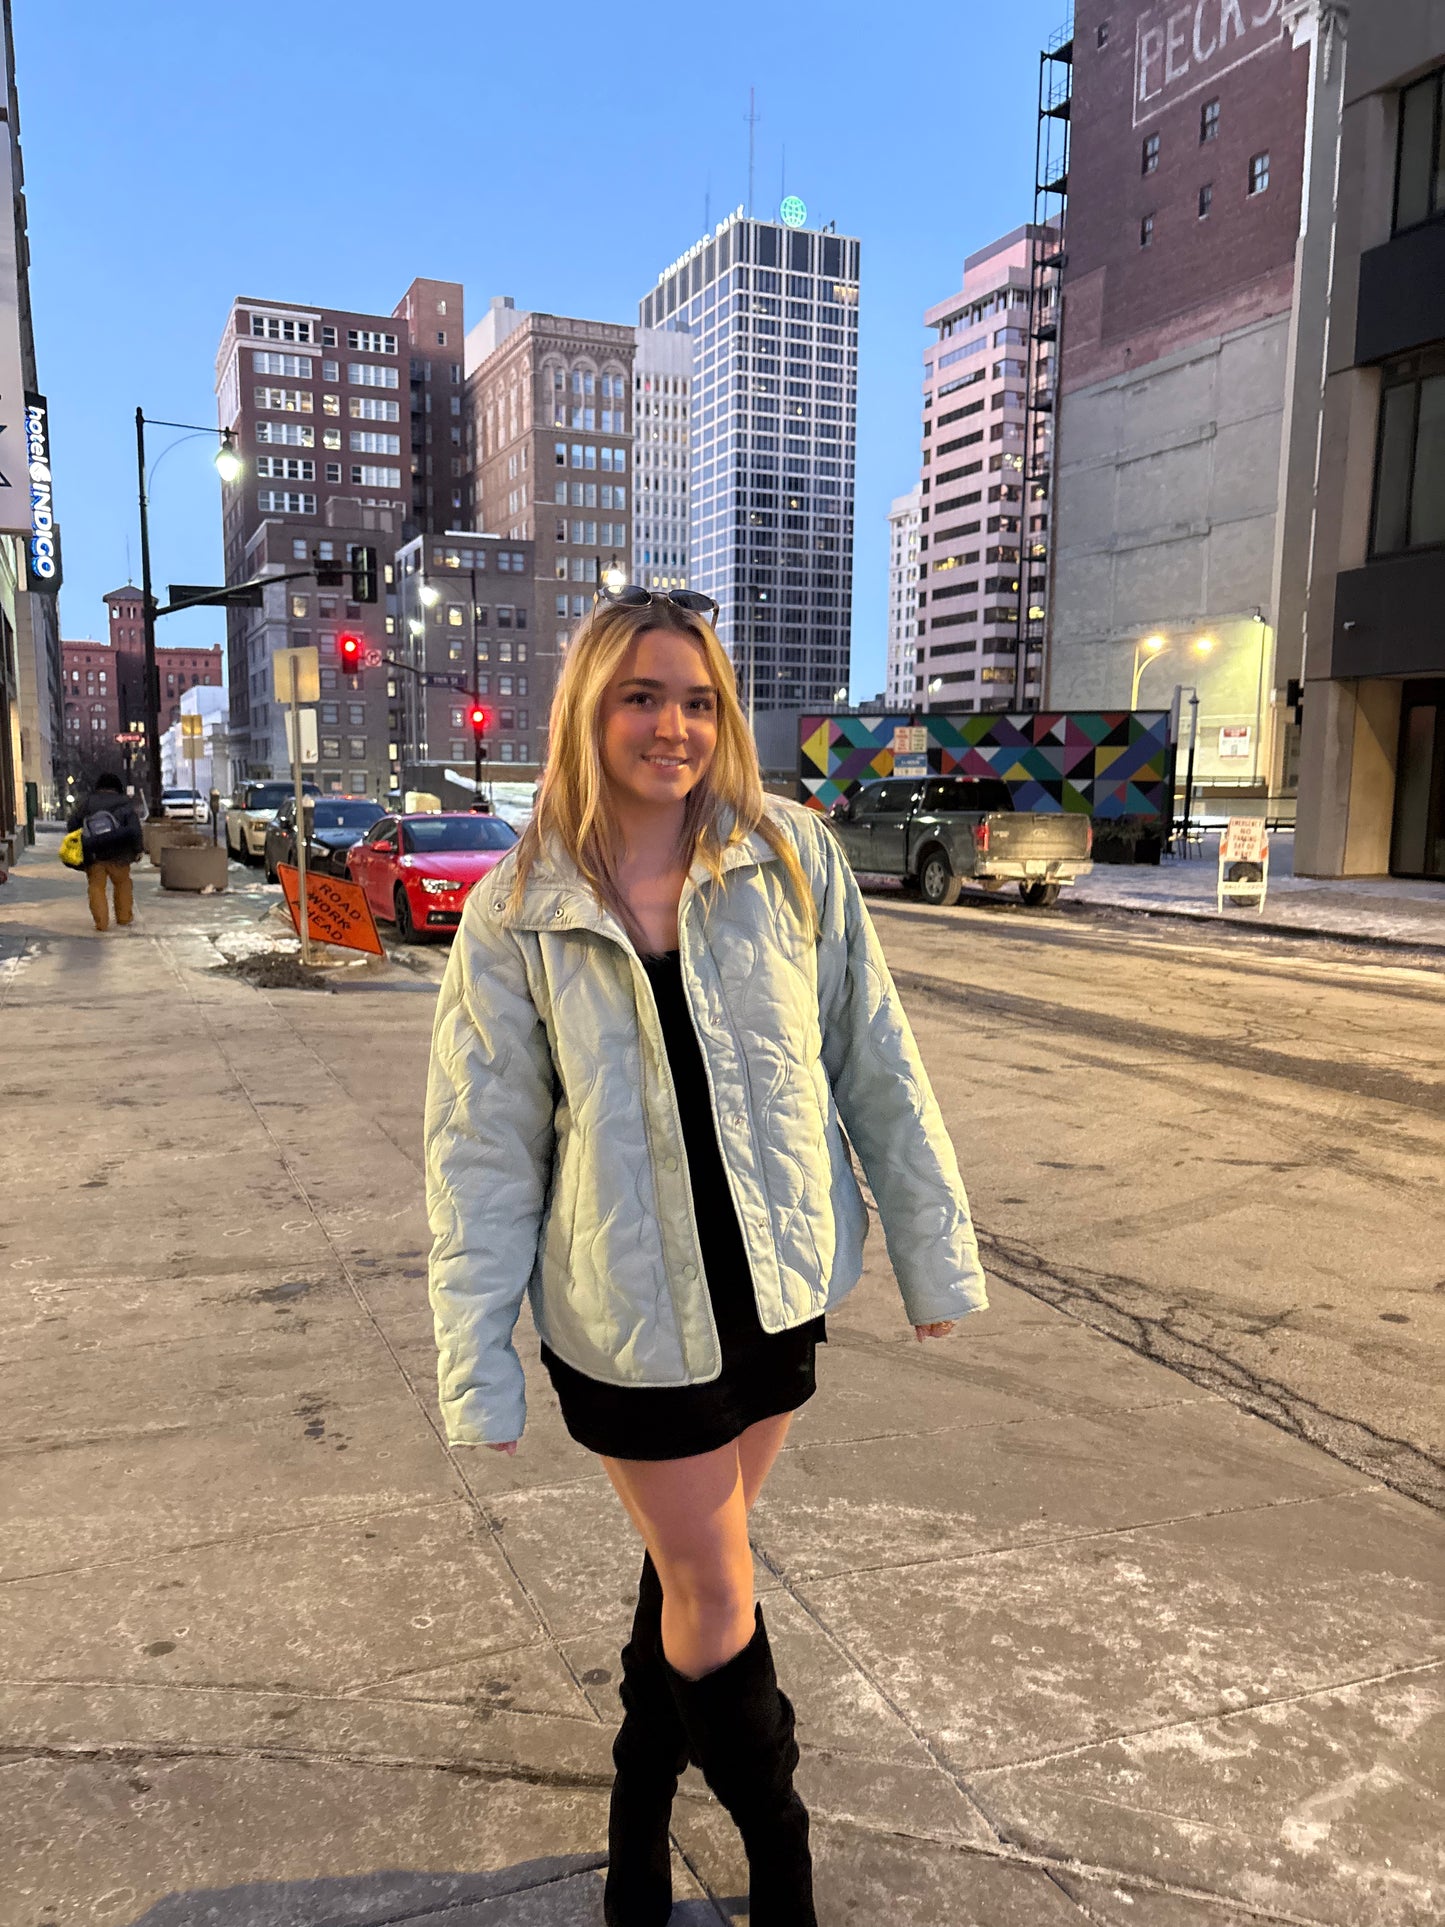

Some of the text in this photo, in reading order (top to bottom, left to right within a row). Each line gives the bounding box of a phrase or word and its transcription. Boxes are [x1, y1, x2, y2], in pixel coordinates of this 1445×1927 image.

[1139, 0, 1278, 101] PECK
[28, 405, 55, 578] hotel INDIGO
[308, 892, 351, 930] WORK
[320, 883, 361, 920] ROAD
